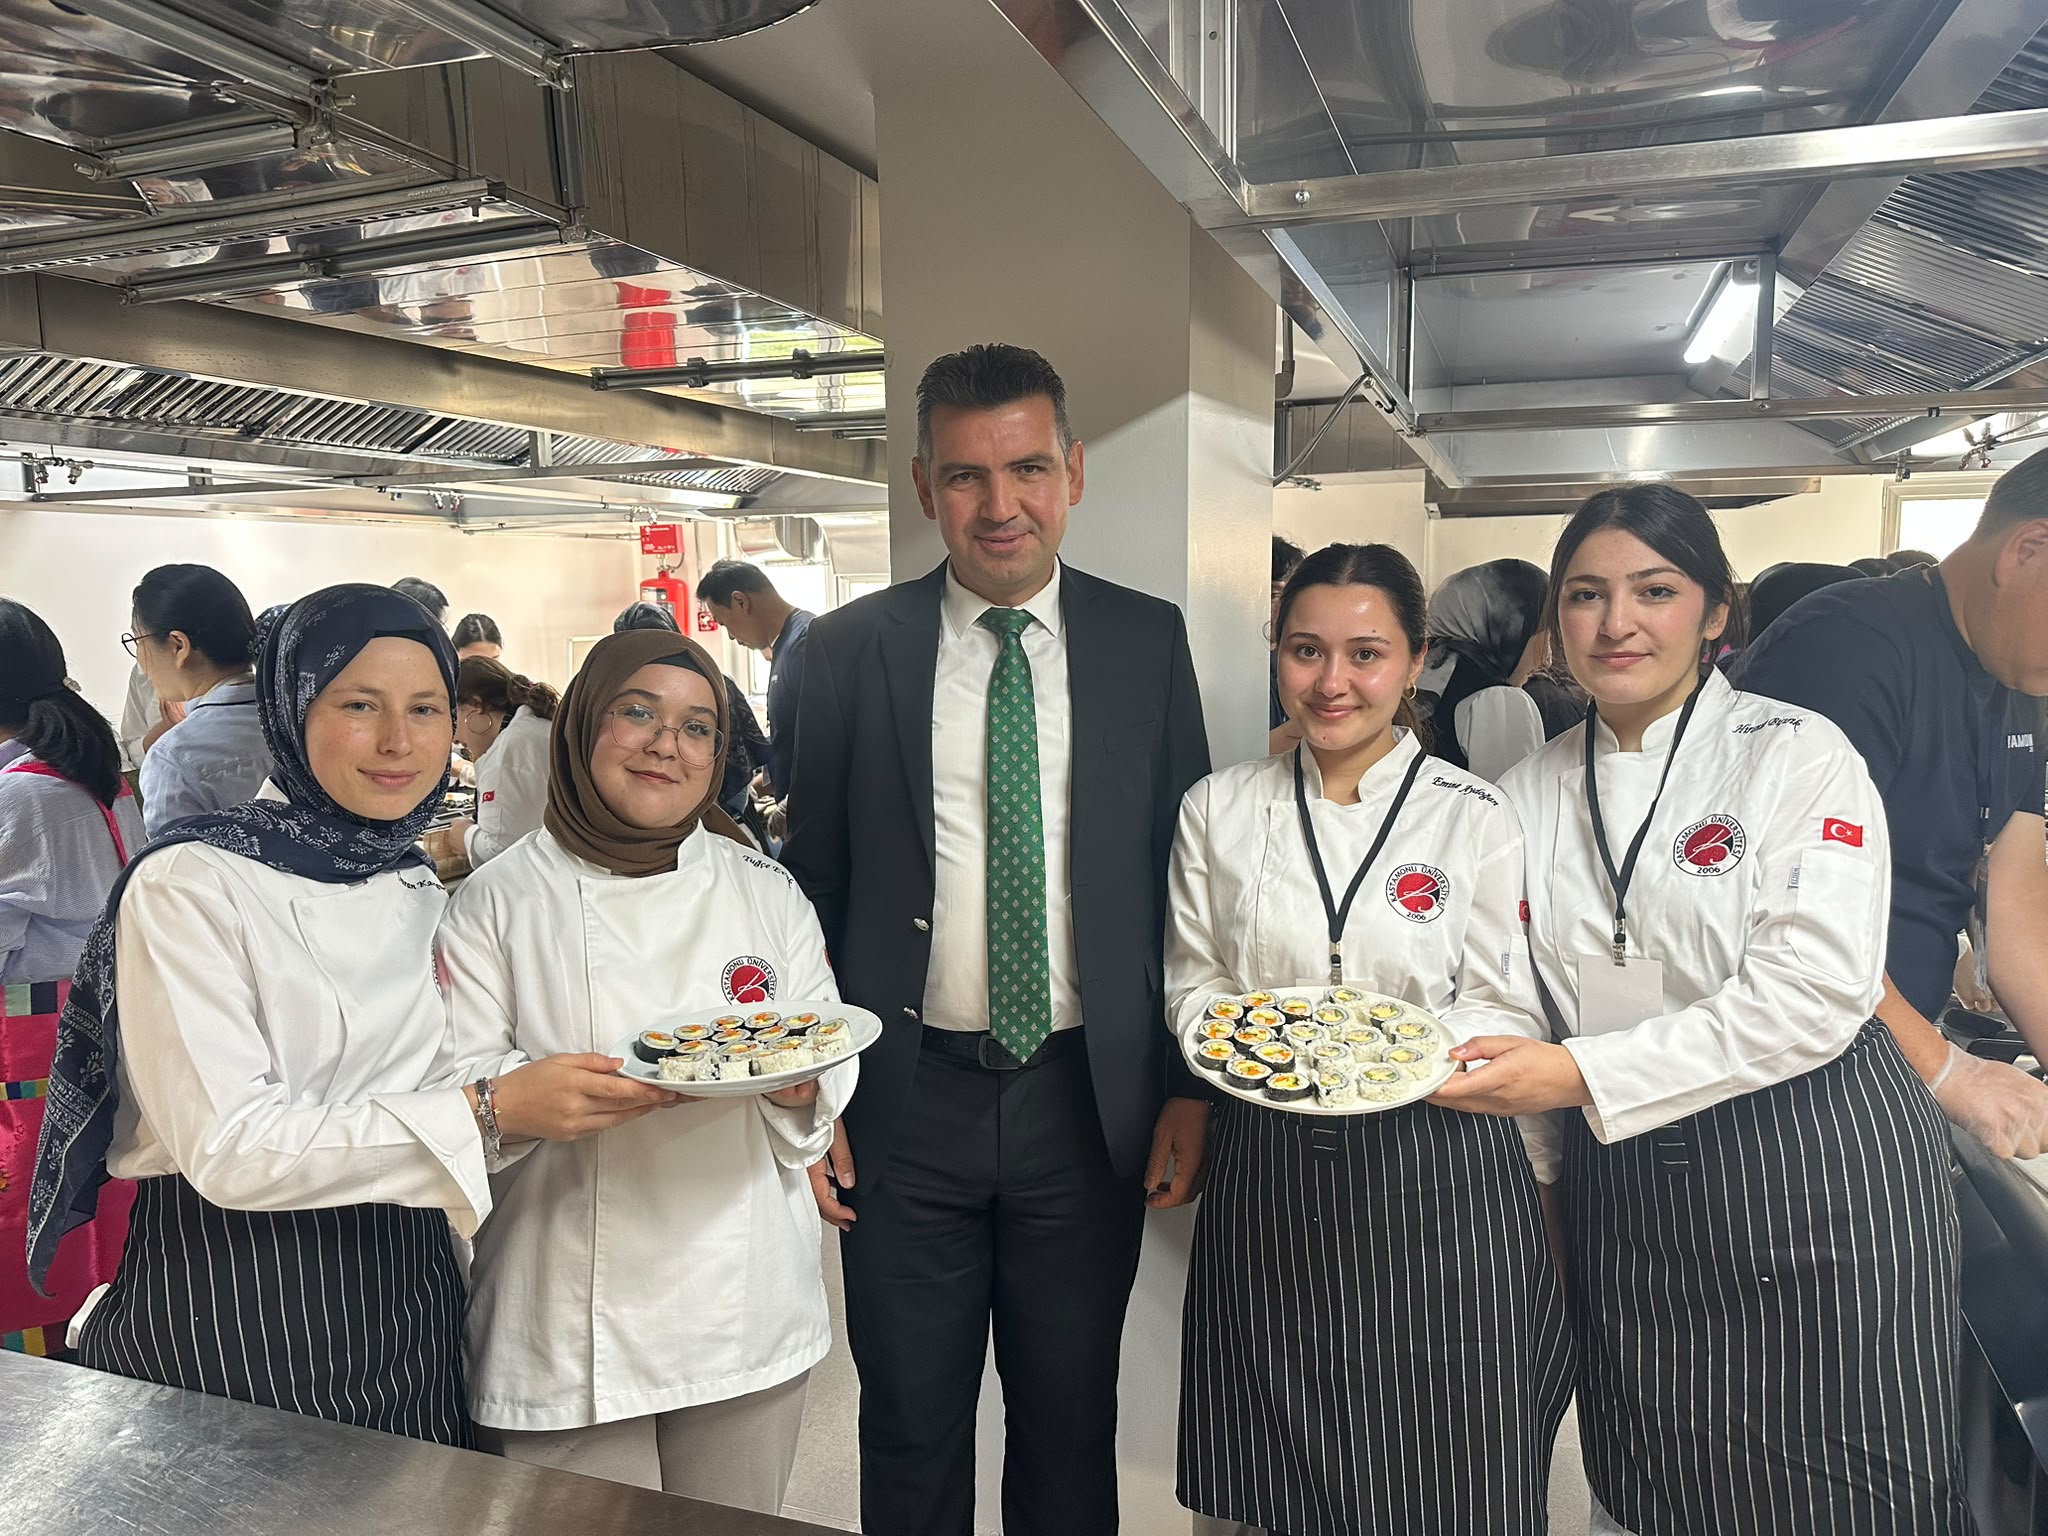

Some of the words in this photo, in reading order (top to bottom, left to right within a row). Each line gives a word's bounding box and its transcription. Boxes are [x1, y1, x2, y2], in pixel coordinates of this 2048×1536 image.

[1676, 819, 1708, 864] KASTAMONU
[1696, 865, 1721, 874] 2006
[1388, 865, 1418, 903] KASTAMONU
[1406, 911, 1427, 921] 2006
